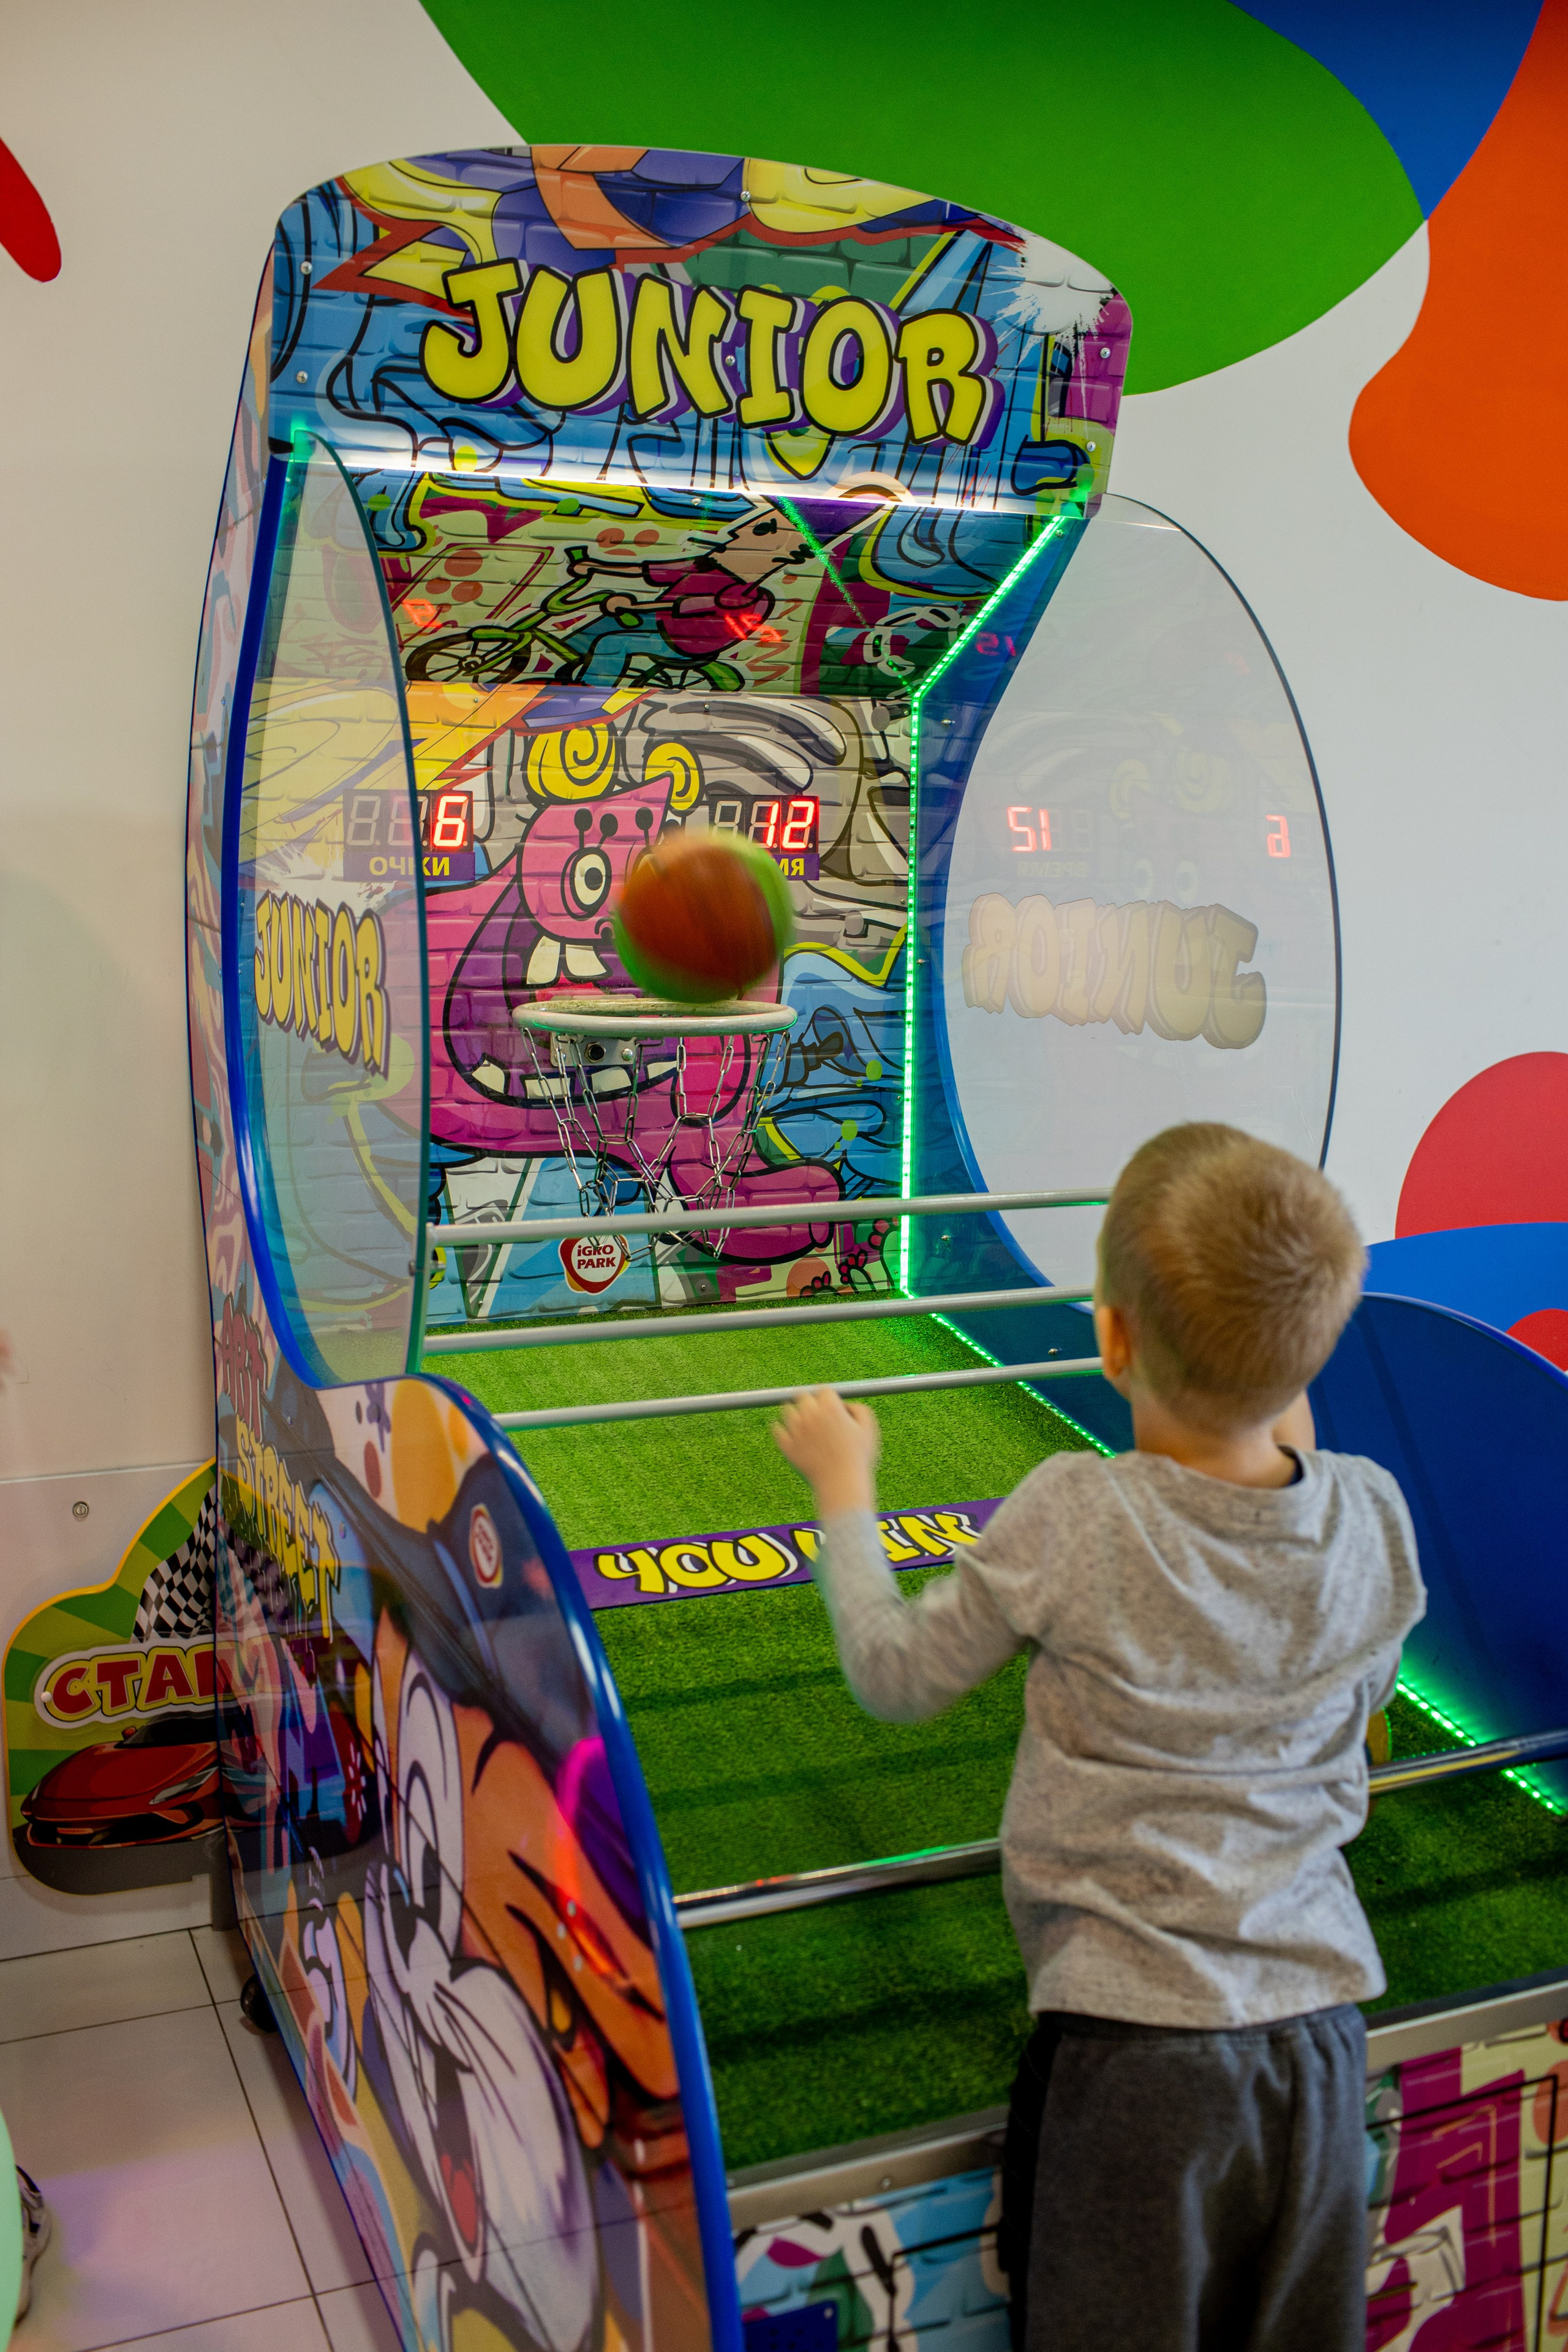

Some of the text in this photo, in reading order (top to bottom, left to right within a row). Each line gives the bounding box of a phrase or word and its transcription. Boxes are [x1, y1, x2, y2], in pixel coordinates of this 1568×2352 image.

[419, 257, 1006, 448] JUNIOR
[433, 795, 467, 846] 6
[764, 800, 816, 850] 12
[254, 889, 391, 1081] JUNIOR
[577, 1257, 616, 1270] PARK
[222, 1291, 267, 1443] ART
[236, 1414, 341, 1644] STREET
[593, 1532, 797, 1594] YOU
